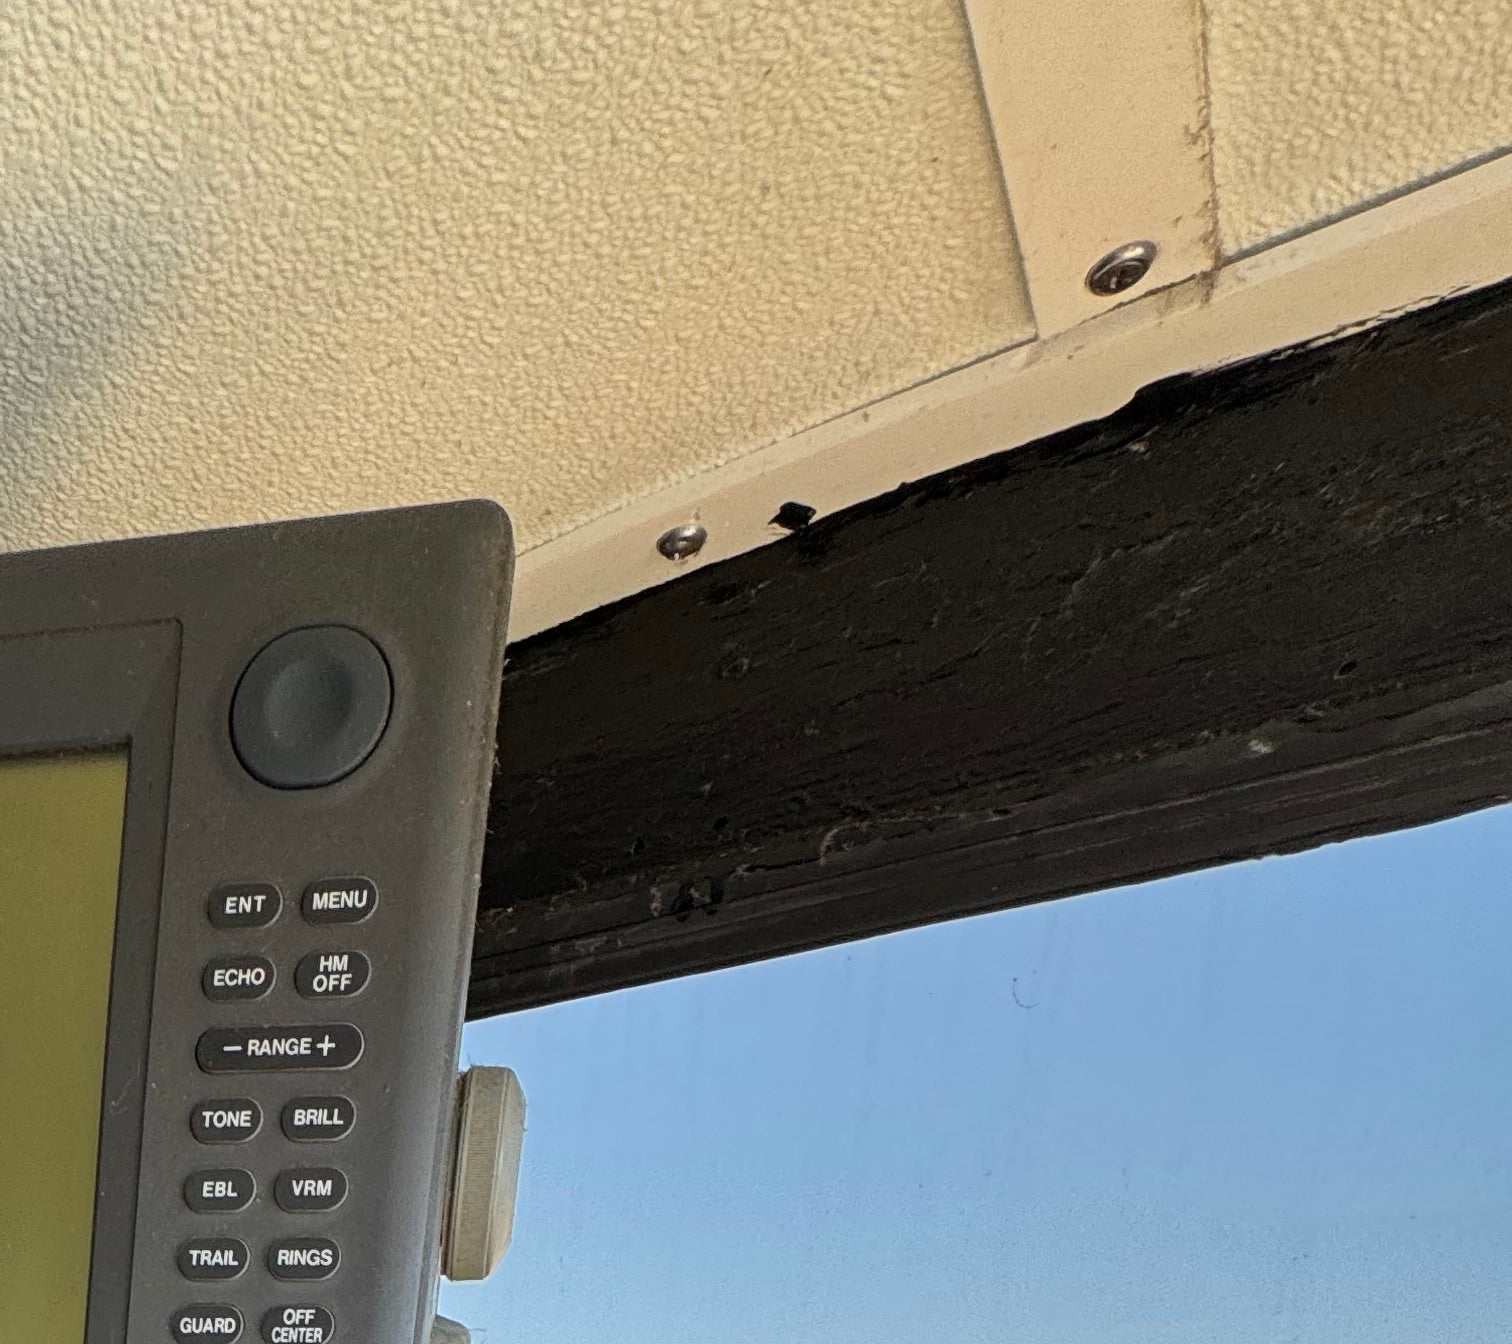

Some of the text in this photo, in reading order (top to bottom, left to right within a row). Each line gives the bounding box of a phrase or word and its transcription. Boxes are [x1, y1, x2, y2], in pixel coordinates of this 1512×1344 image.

[224, 894, 266, 915] ENT
[312, 889, 368, 911] MENU
[319, 955, 348, 972] HM
[213, 967, 266, 987] ECHO
[312, 973, 353, 993] OFF
[247, 1036, 313, 1056] RANGE
[202, 1110, 252, 1128] TONE
[293, 1109, 344, 1126] BRILL
[202, 1181, 238, 1198] EBL
[292, 1179, 333, 1196] VRM
[189, 1249, 239, 1267] TRAIL
[277, 1249, 333, 1267] RINGS
[180, 1316, 236, 1335] GUARD
[283, 1309, 316, 1326] OFF
[271, 1327, 323, 1344] CENTER
